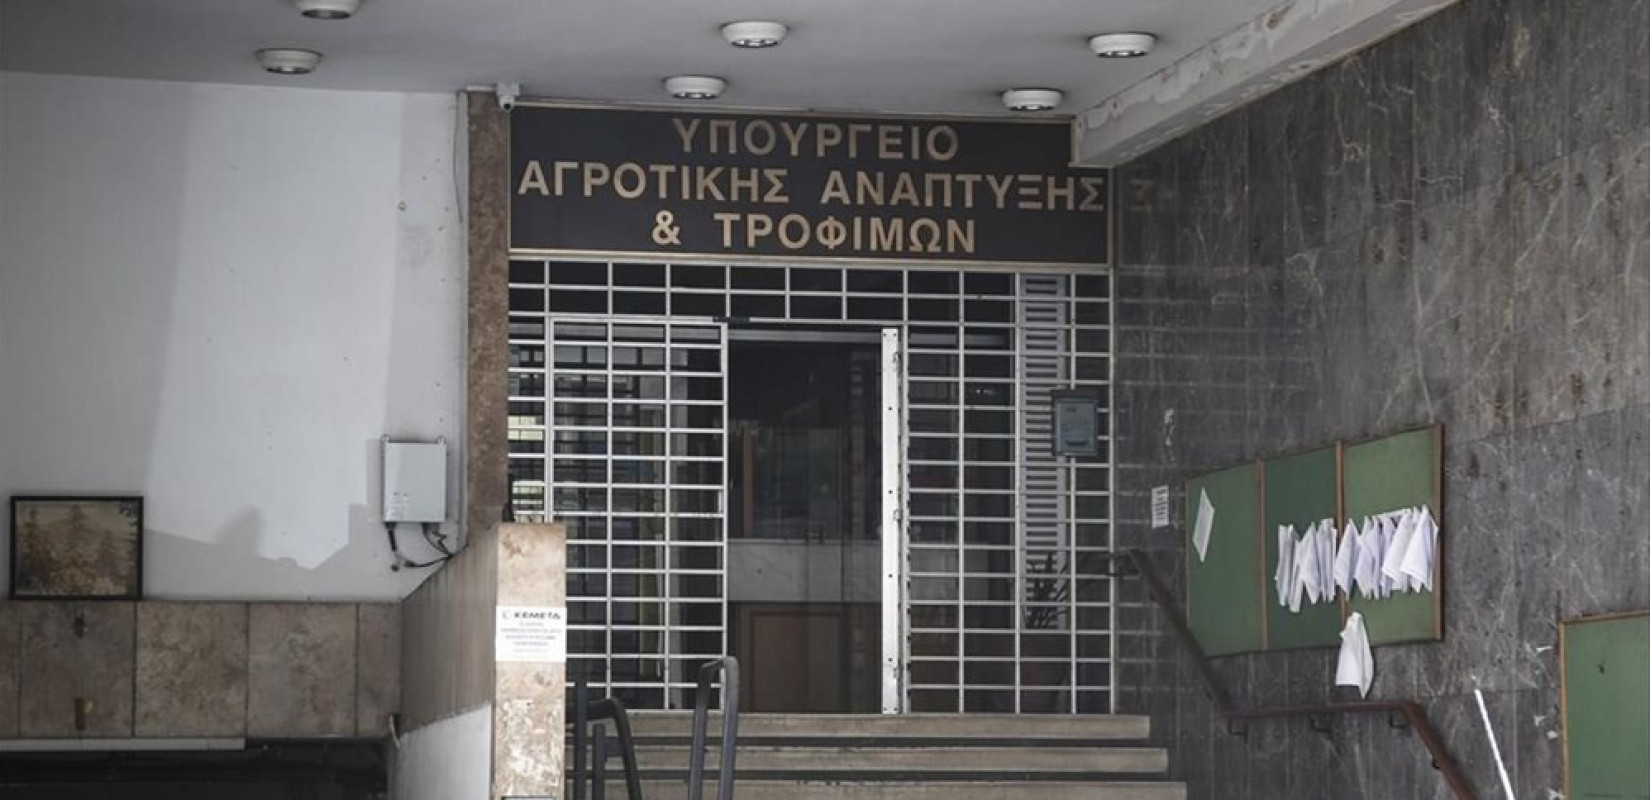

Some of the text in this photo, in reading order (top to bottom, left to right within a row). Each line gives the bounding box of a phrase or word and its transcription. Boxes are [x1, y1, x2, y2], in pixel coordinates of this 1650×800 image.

[673, 118, 958, 161] ΥΠΟΥΡΓΕΙΟ
[518, 161, 1105, 212] ΑΓΡΟΤΙΚΗΣ ΑΝΑΠΤΥΞΗΣ
[651, 210, 976, 254] & ΤΡΟΦΙΜΩΝ
